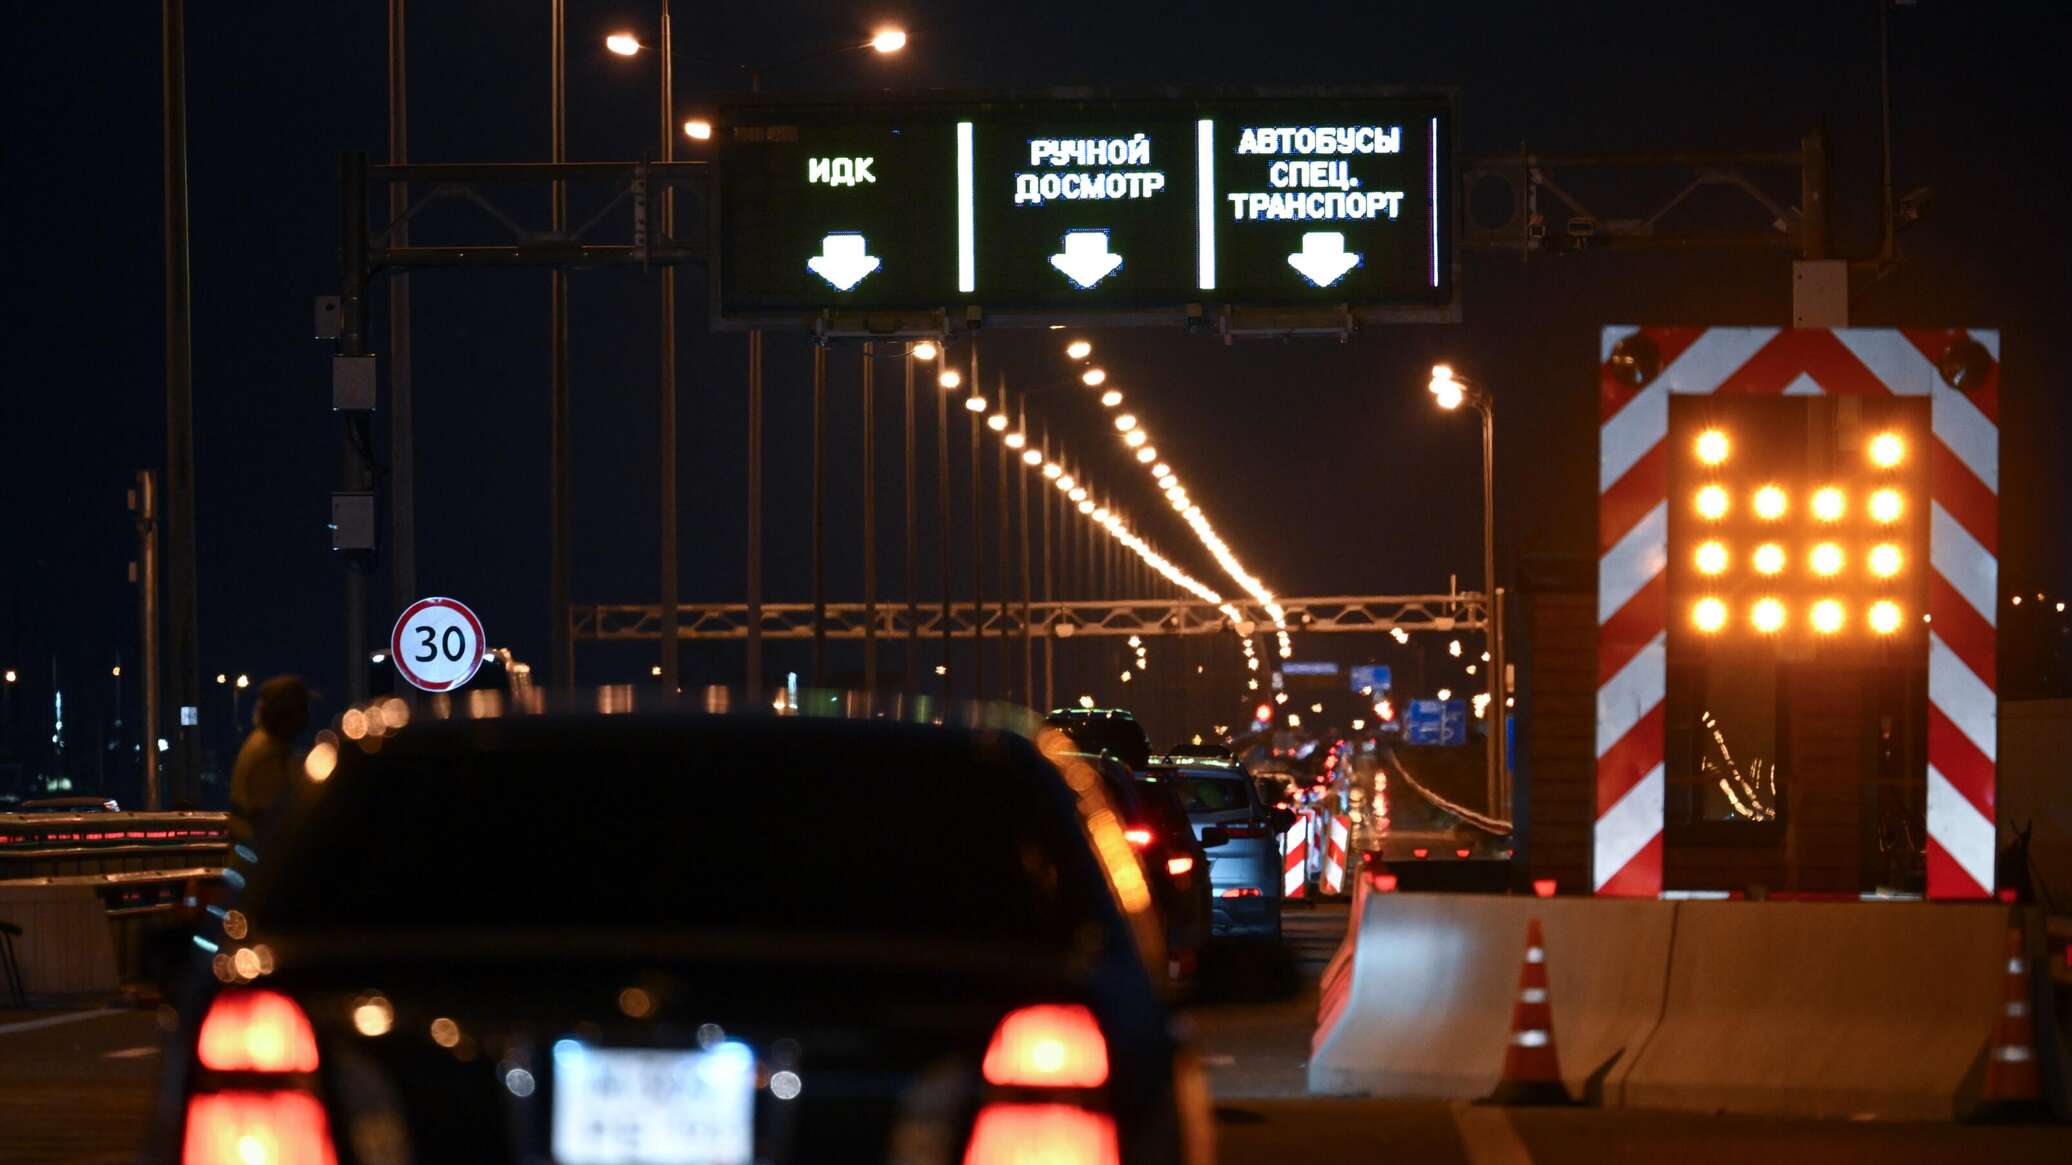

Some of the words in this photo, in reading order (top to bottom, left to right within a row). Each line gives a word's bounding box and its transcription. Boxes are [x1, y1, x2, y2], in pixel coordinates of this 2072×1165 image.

[1029, 133, 1150, 166] РУЧНОЙ
[1239, 126, 1401, 154] АВТОБУСЫ
[808, 157, 876, 187] ИДК
[1269, 160, 1359, 189] СПЕЦ.
[1015, 172, 1164, 203] ДОСМОТР
[1228, 192, 1403, 219] ТРАНСПОРТ
[415, 625, 466, 662] 30
